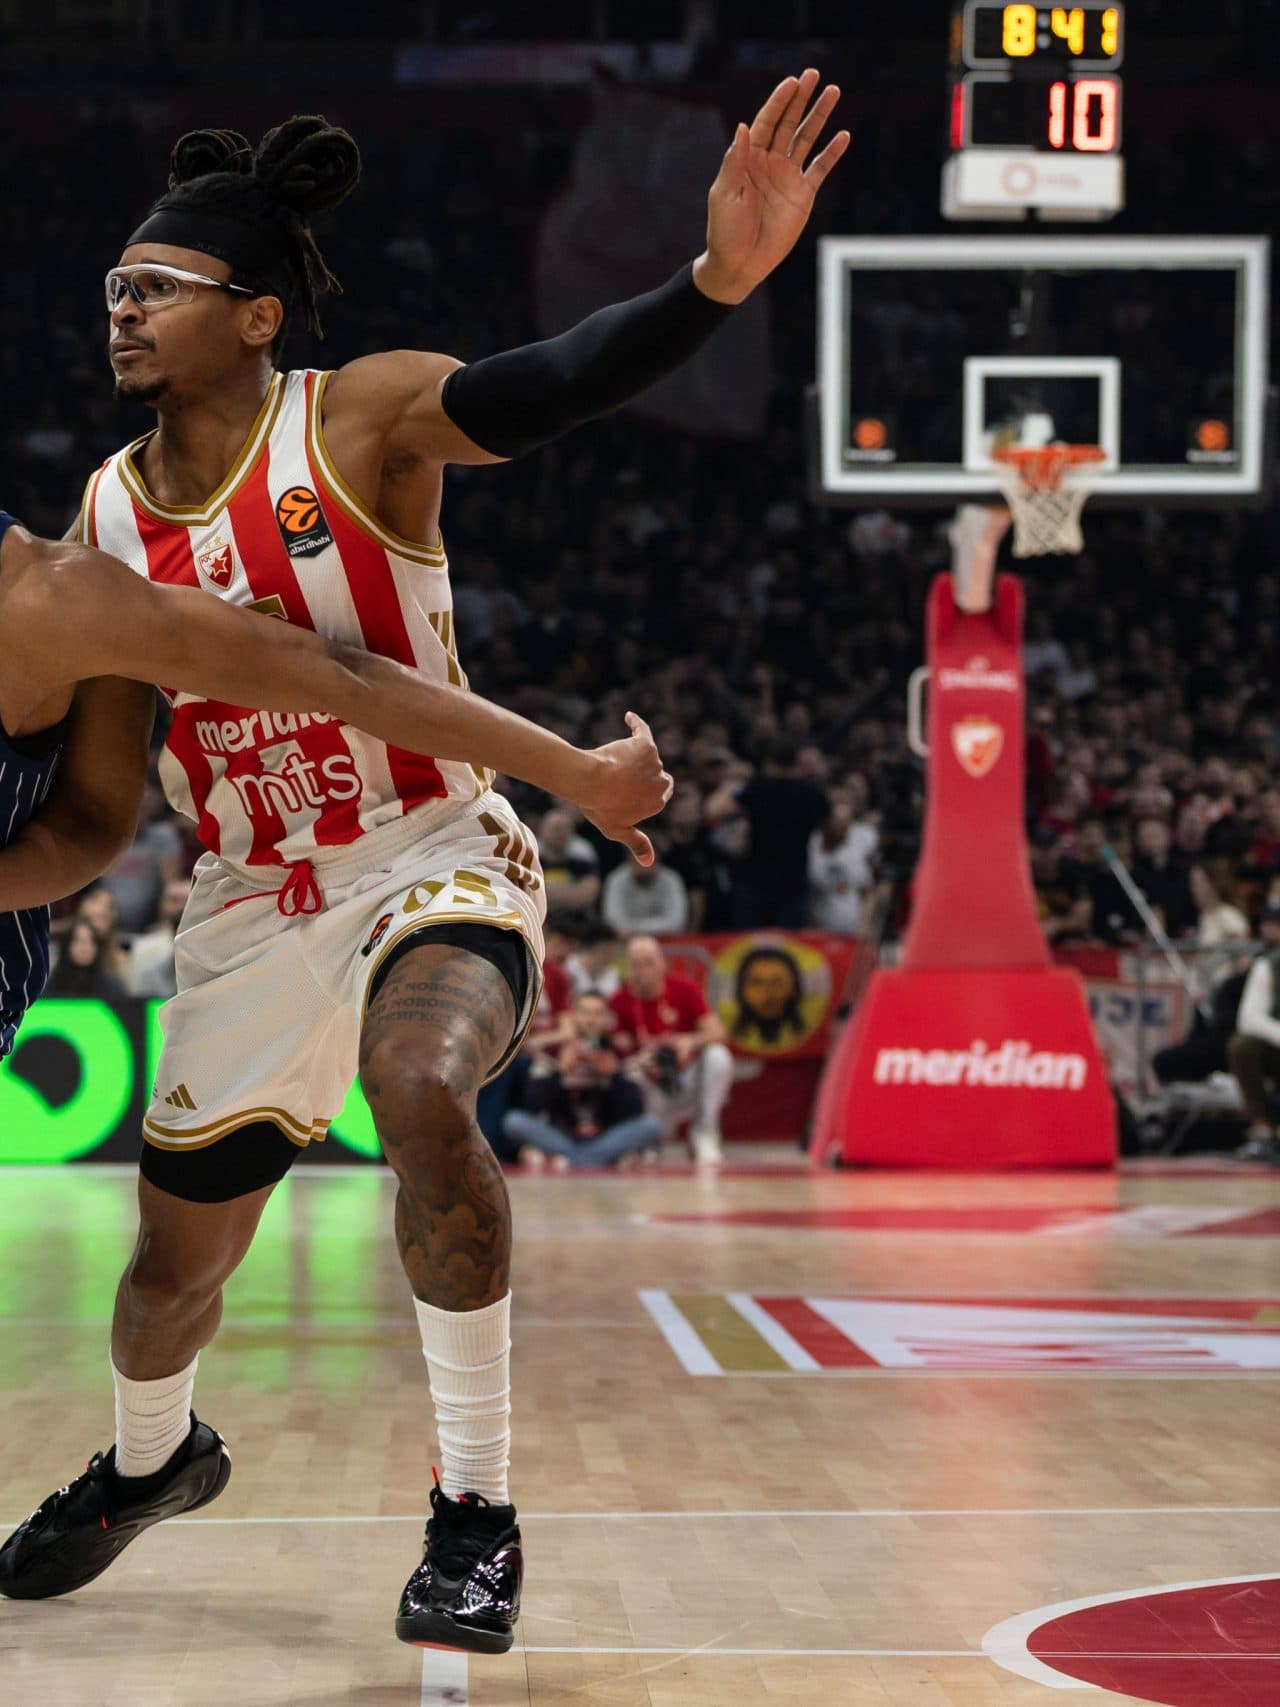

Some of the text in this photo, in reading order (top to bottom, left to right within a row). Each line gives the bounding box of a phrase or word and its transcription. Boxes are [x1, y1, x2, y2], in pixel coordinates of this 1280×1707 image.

[1002, 3, 1119, 56] 8:41
[1048, 80, 1117, 151] 10
[231, 754, 361, 817] mts
[873, 1038, 1088, 1092] meridian
